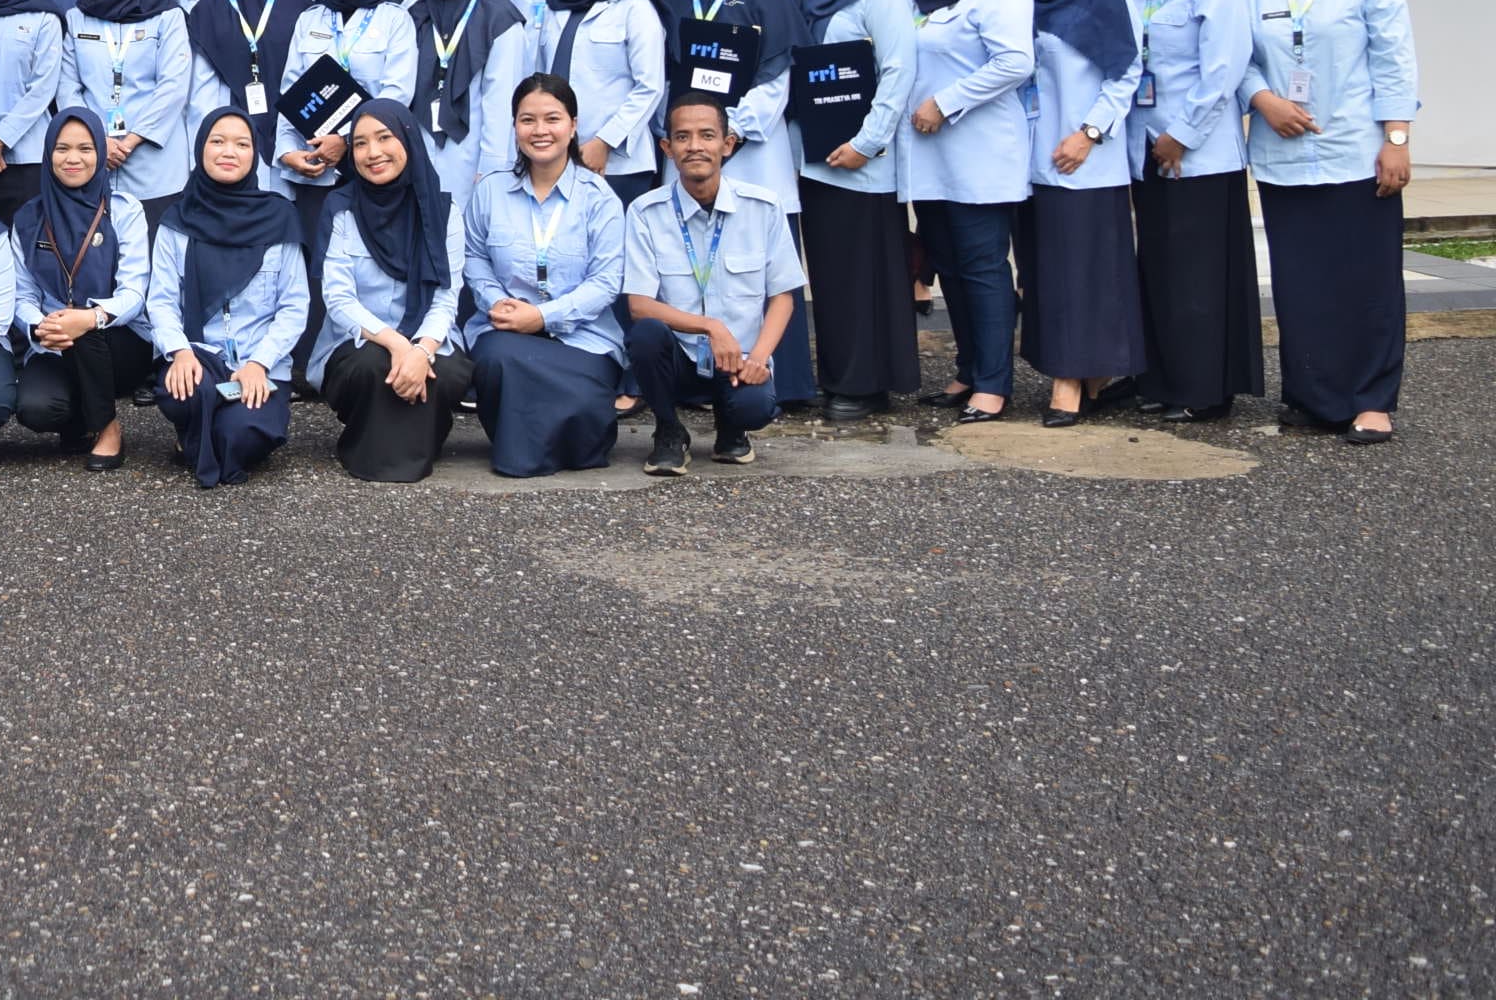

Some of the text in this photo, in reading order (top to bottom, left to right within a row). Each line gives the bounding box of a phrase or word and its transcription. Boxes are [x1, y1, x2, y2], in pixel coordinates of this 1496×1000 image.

[690, 42, 719, 59] rri
[701, 75, 721, 87] MC
[808, 63, 836, 83] rri
[299, 92, 324, 119] rri
